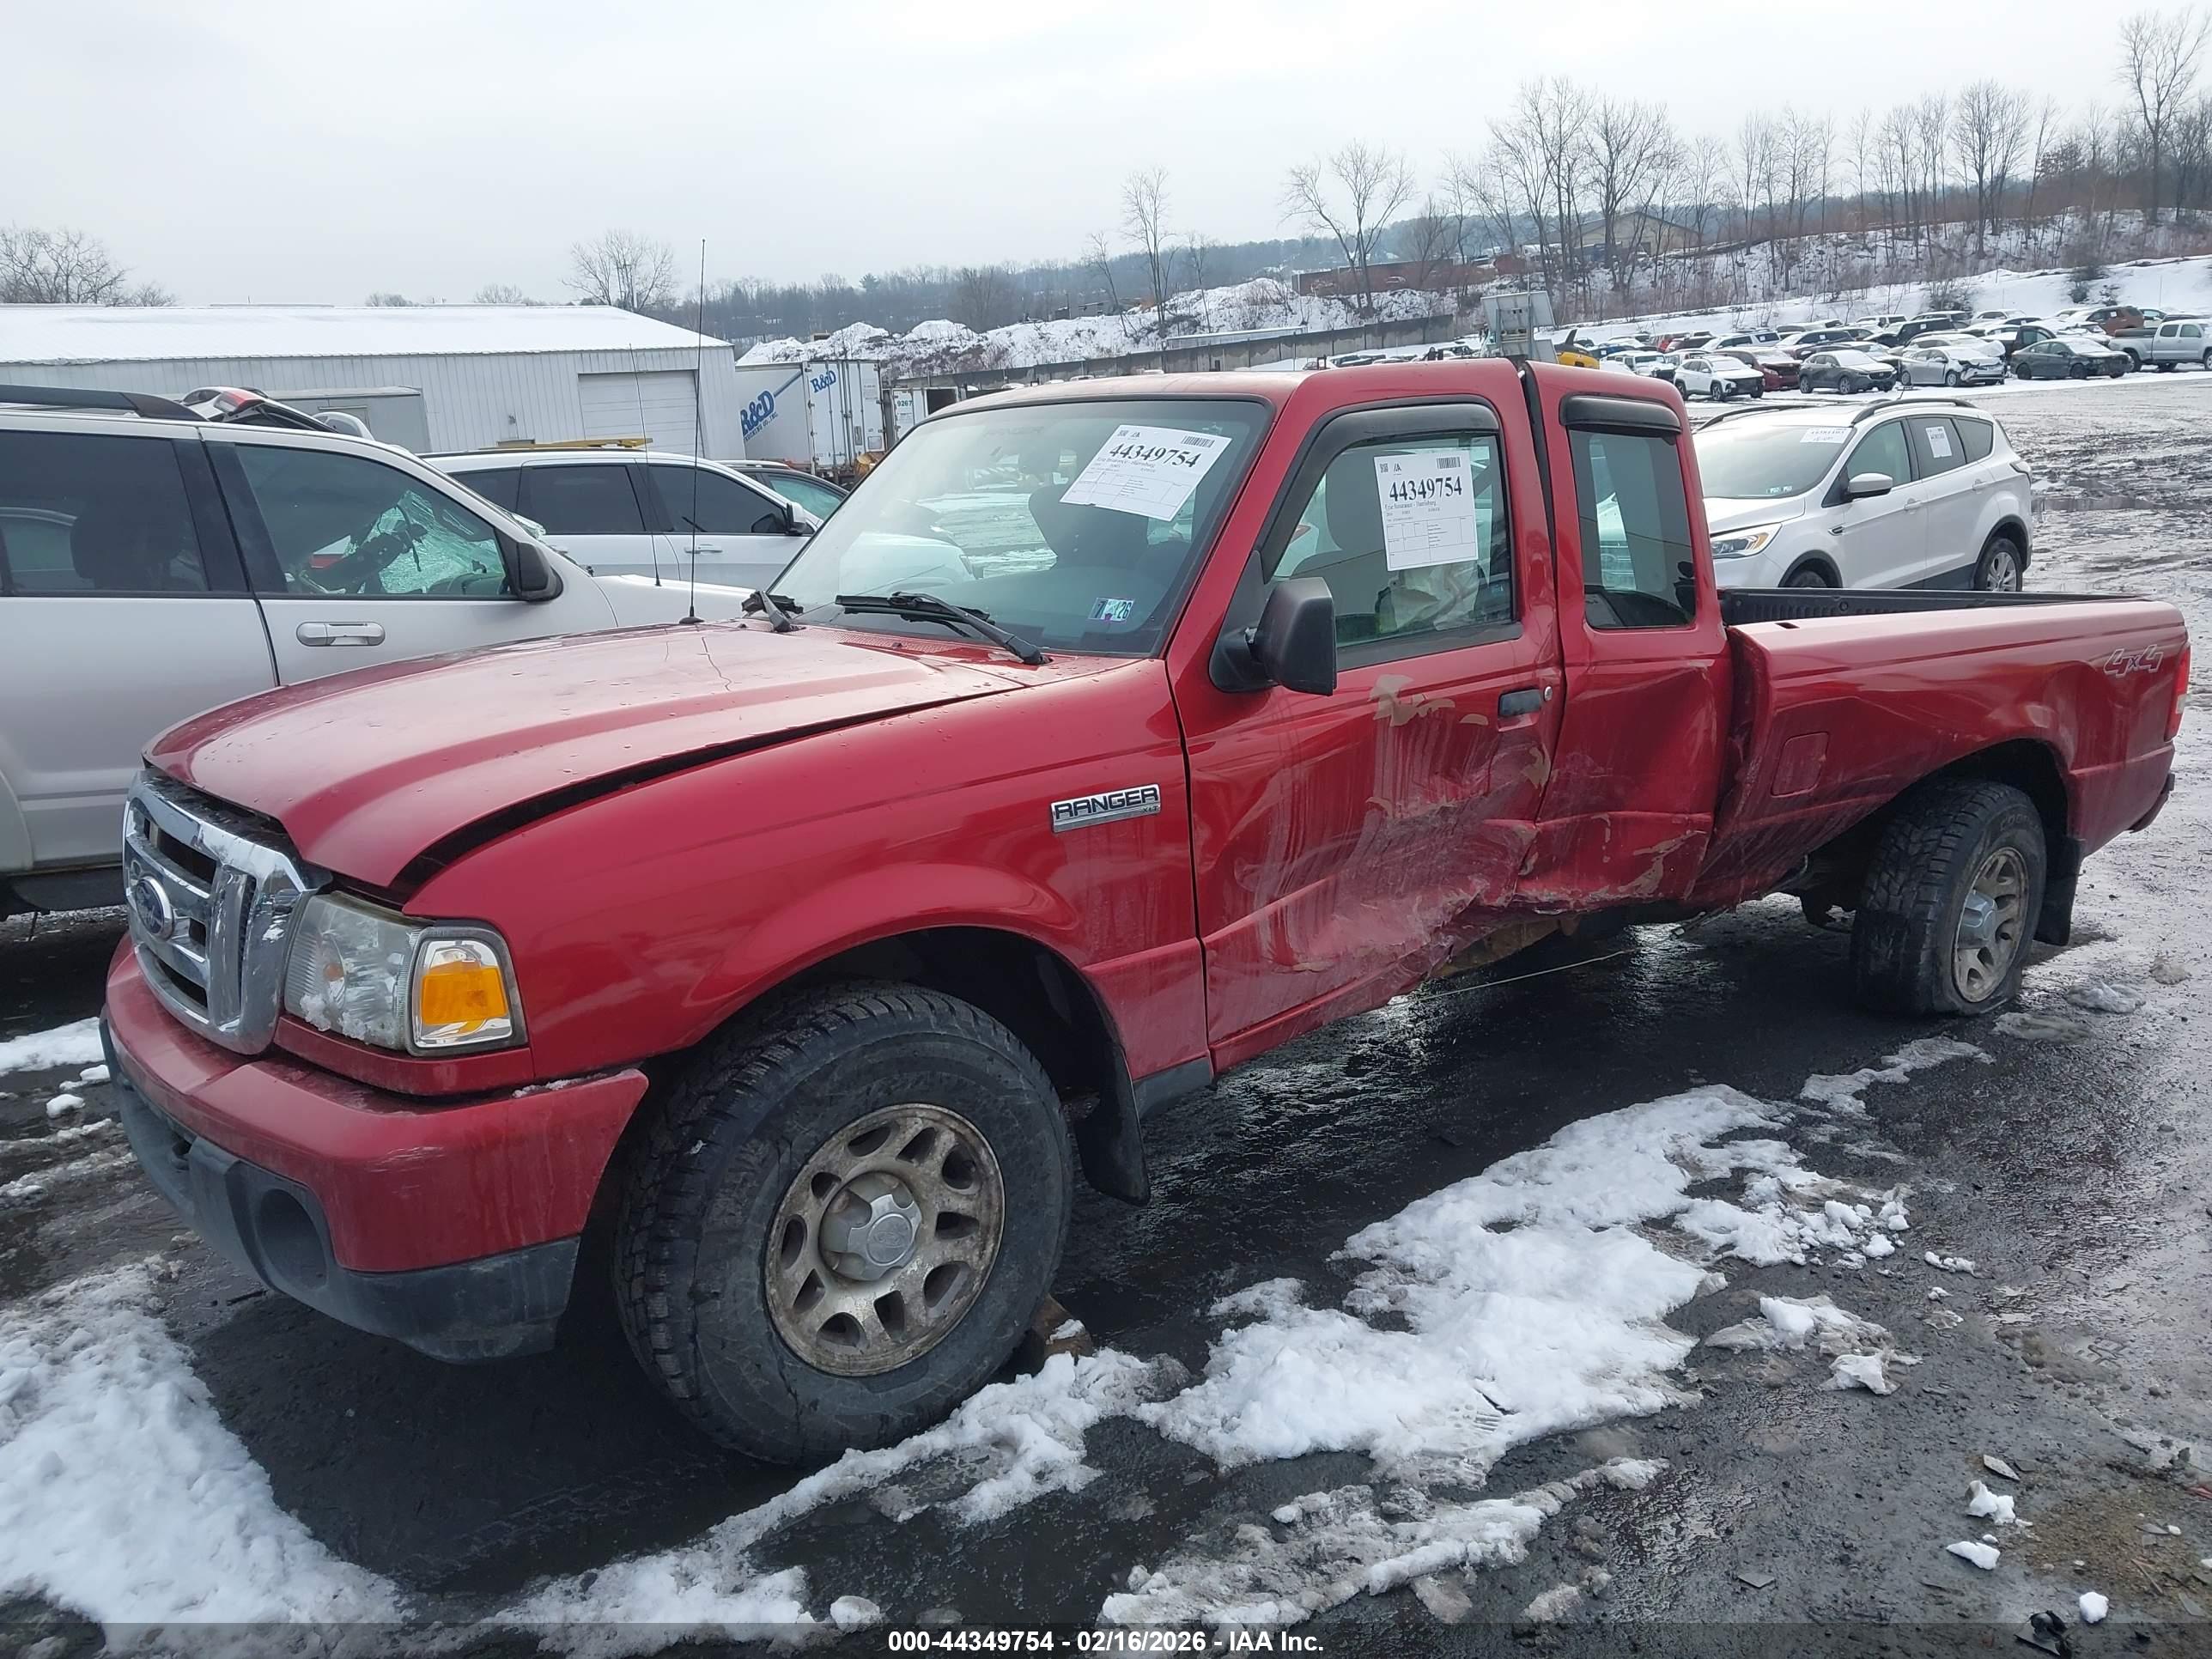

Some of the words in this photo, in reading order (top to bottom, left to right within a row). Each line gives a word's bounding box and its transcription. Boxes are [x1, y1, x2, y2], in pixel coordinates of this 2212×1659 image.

[811, 370, 836, 393] R&D
[739, 390, 775, 437] R&D
[1109, 443, 1202, 468] 44349754
[1389, 476, 1462, 502] 44349754
[1054, 787, 1158, 819] RANGER
